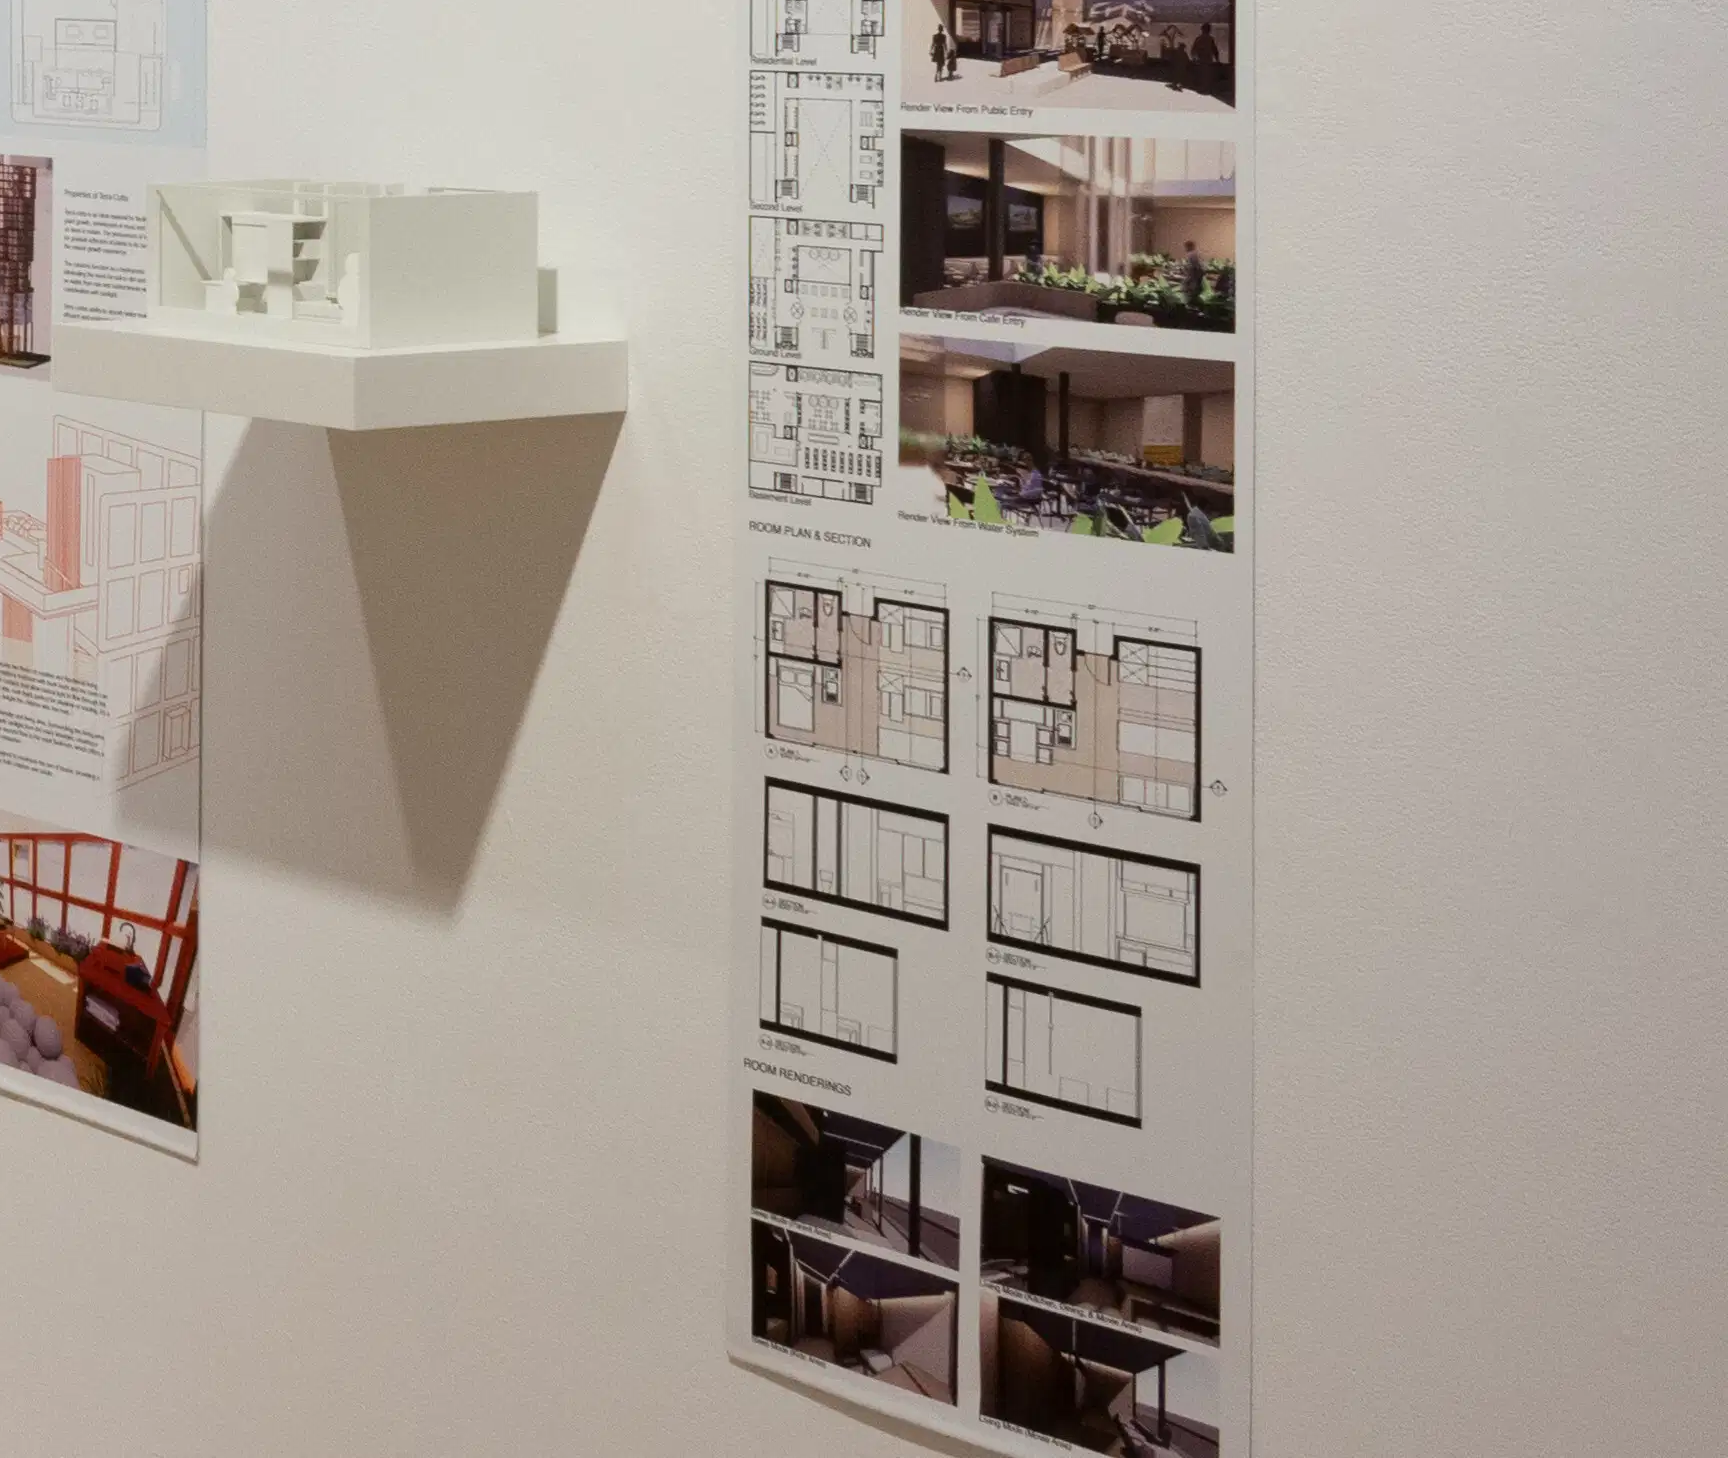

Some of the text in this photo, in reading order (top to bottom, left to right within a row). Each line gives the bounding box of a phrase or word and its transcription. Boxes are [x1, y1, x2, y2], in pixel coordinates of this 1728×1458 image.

[900, 102, 1033, 118] Render View From Public Entry
[749, 520, 871, 548] ROOM PLAN & SECTION
[744, 1057, 852, 1096] ROOM RENDERINGS
